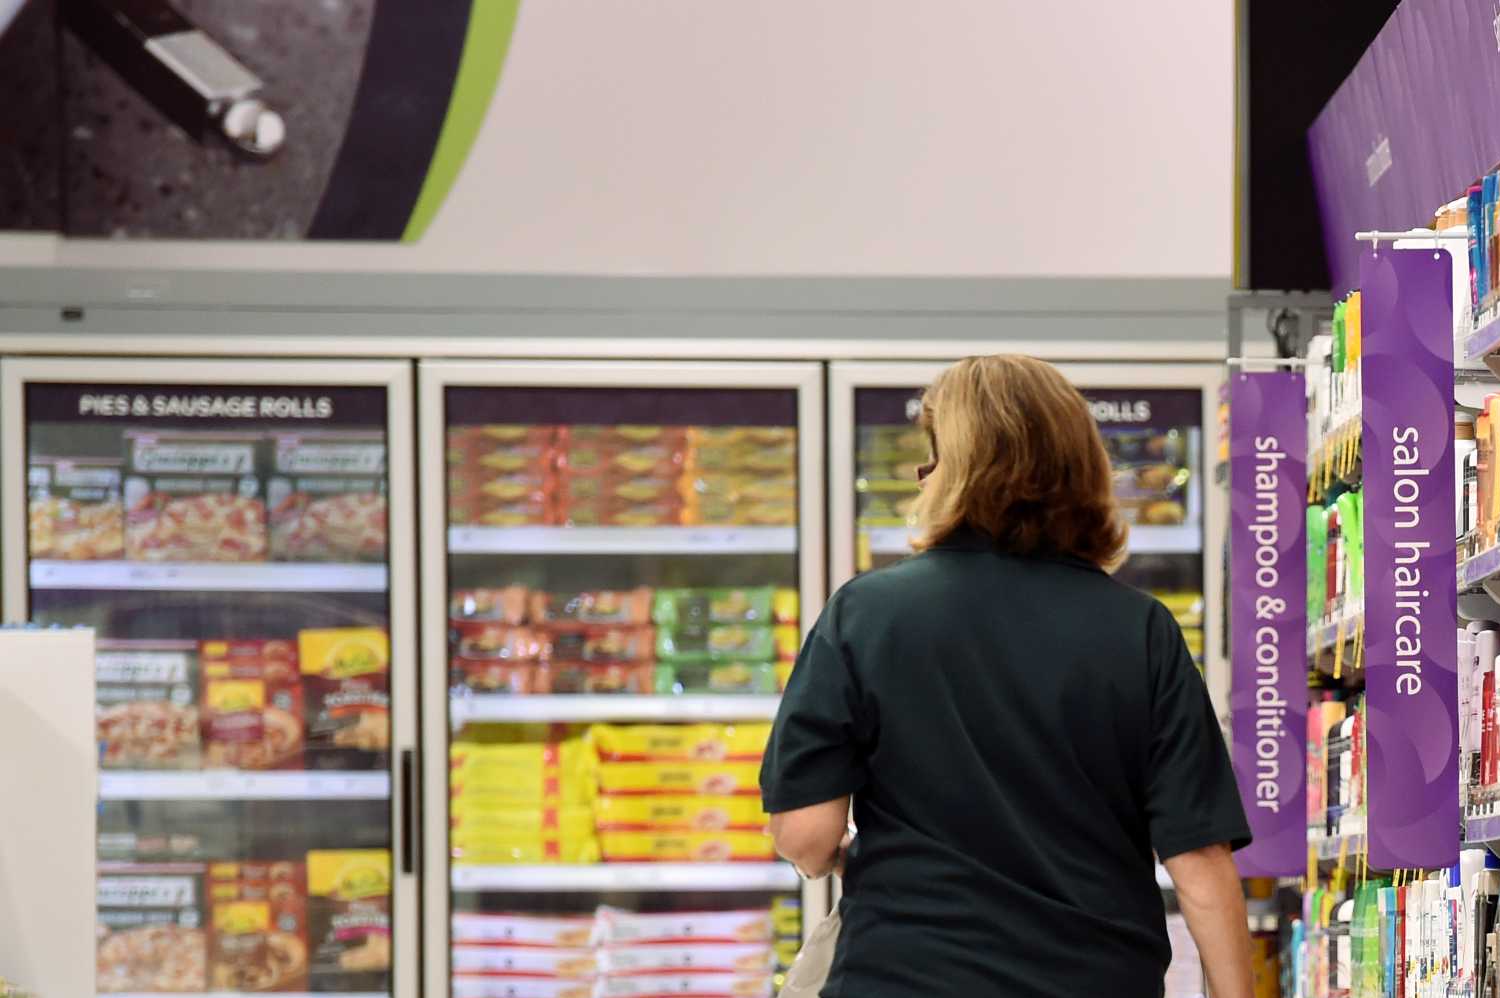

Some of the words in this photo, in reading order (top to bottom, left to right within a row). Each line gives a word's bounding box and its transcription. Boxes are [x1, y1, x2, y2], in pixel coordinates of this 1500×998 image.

[79, 395, 129, 416] PIES
[131, 396, 150, 416] &
[152, 396, 257, 418] SAUSAGE
[259, 397, 332, 419] ROLLS
[1248, 437, 1286, 587] shampoo
[1393, 427, 1429, 527] salon
[1256, 596, 1285, 619] &
[1395, 542, 1430, 694] haircare
[1256, 627, 1286, 812] conditioner
